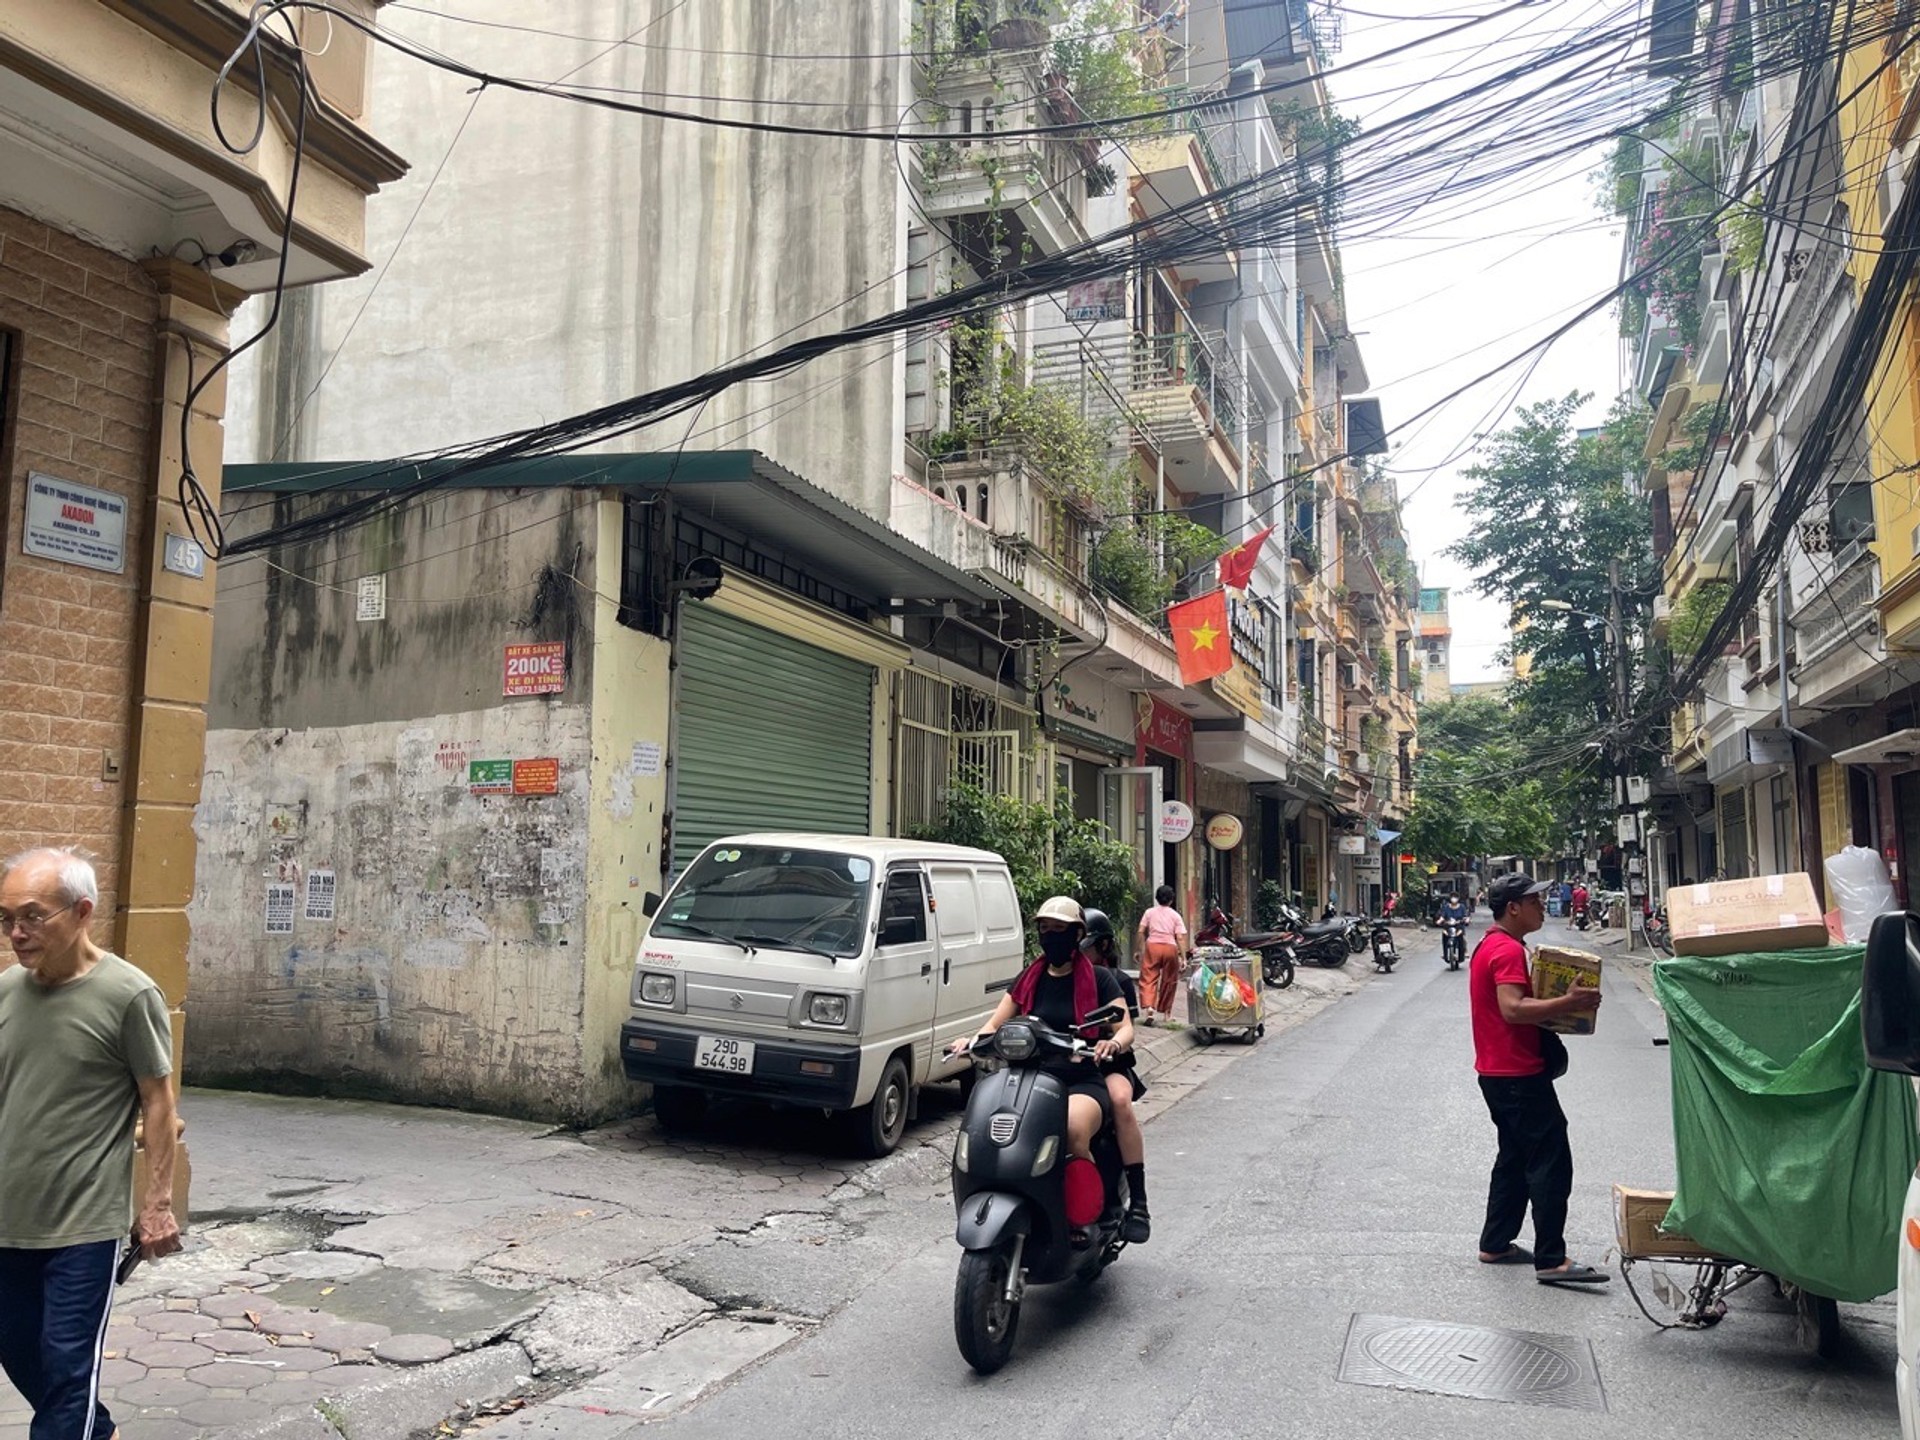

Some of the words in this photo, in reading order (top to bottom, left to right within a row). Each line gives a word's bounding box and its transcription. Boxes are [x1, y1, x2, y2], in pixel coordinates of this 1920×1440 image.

[49, 487, 55, 496] TY
[61, 504, 94, 525] AKADON
[173, 541, 198, 570] 45
[507, 656, 551, 676] 200K
[508, 677, 521, 686] XE
[645, 952, 673, 960] SUPER
[713, 1039, 739, 1055] 29D
[701, 1053, 747, 1072] 544.98
